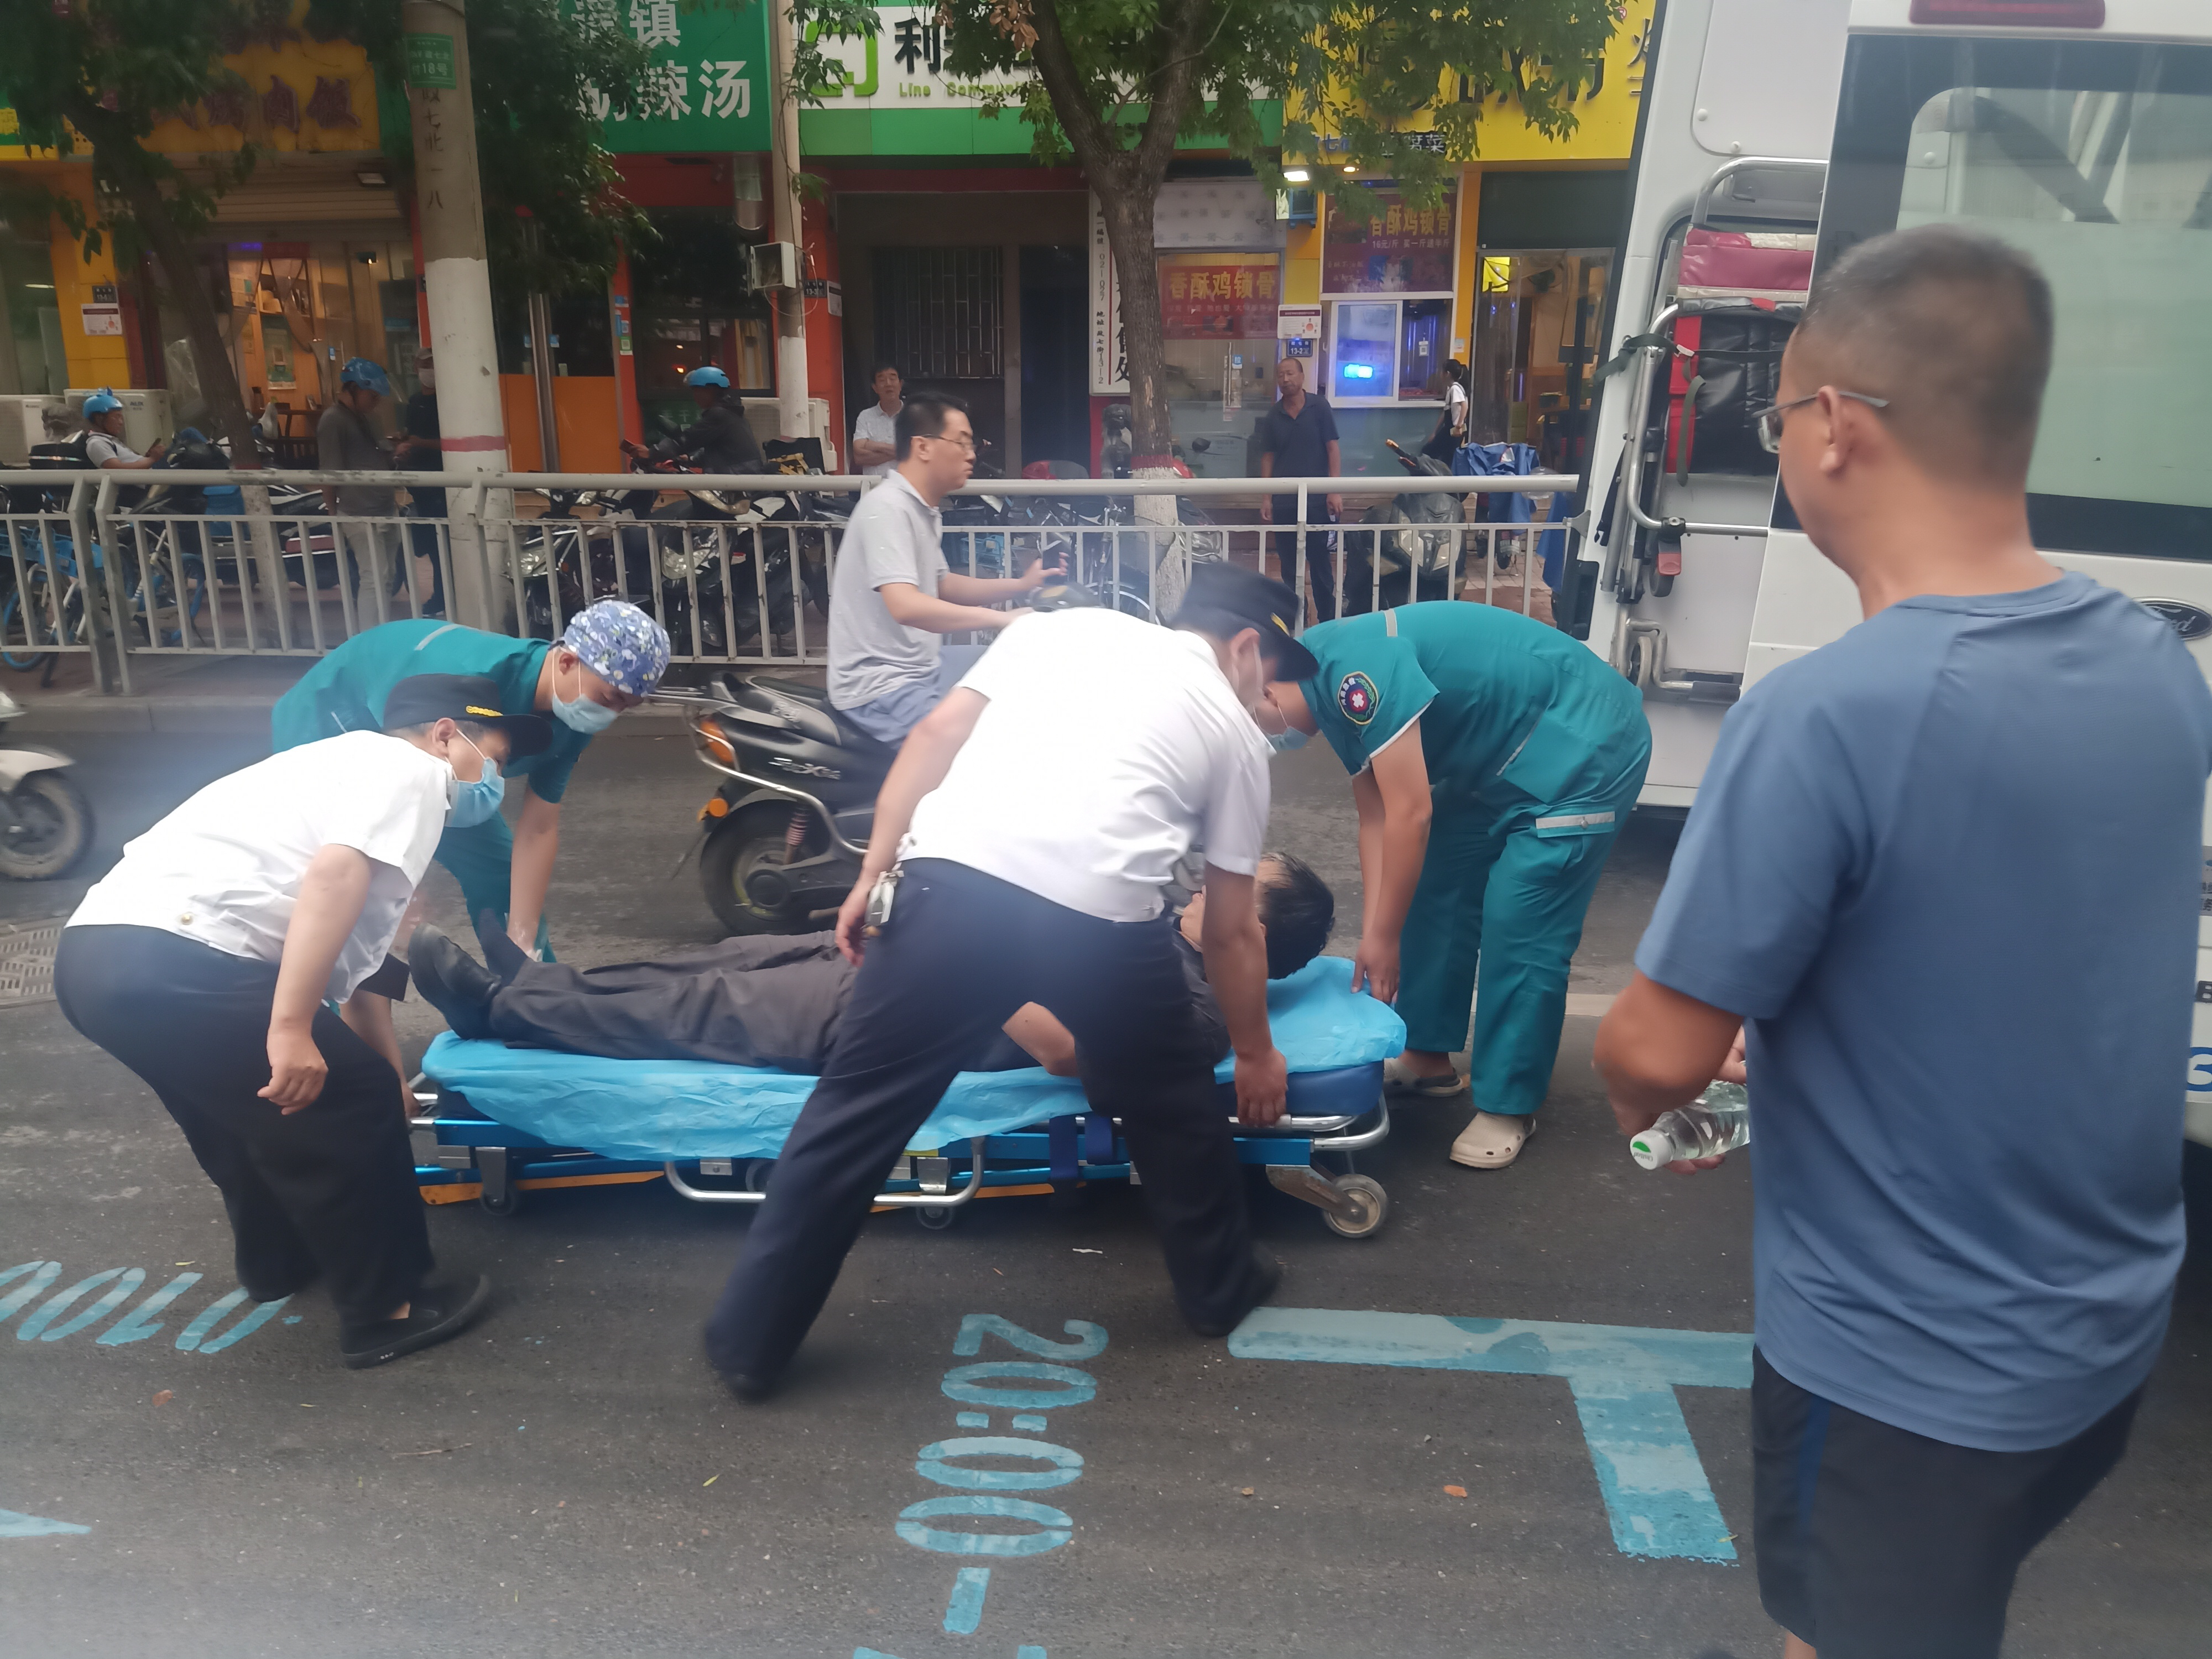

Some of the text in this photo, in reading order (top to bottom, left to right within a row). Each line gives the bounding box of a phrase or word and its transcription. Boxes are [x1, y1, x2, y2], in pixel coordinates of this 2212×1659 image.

[1170, 271, 1275, 300] 香酥鸡锁骨
[852, 1313, 1109, 1659] 20:00-
